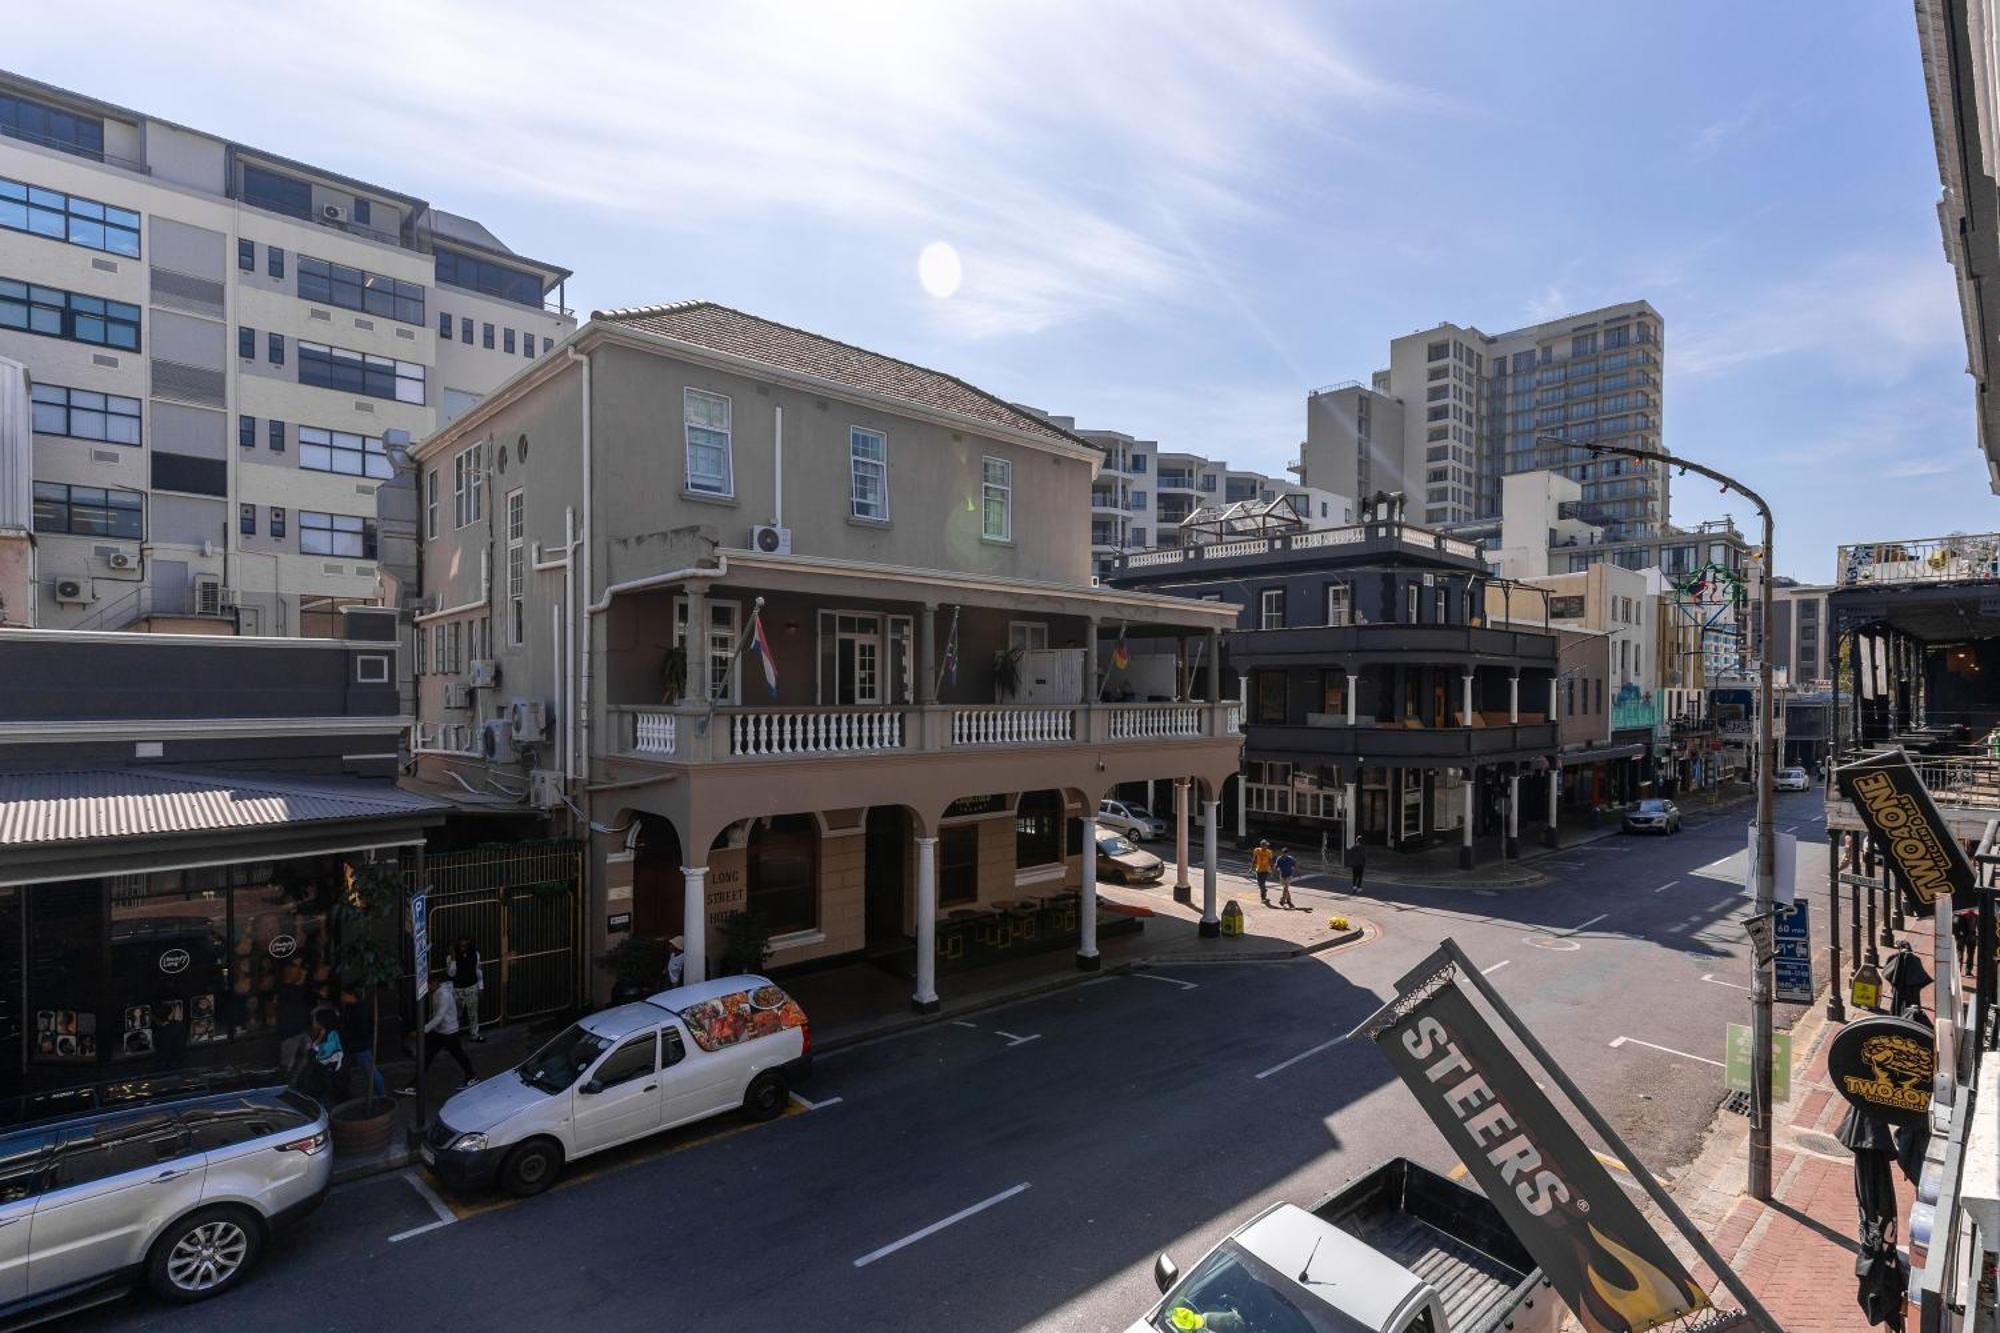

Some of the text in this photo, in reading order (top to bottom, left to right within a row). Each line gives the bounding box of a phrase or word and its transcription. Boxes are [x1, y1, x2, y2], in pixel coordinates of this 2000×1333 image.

[712, 870, 739, 884] LONG
[707, 889, 744, 905] STREET
[1777, 925, 1790, 933] 60
[1844, 1075, 1930, 1107] TWO4ON
[1402, 1016, 1570, 1217] STEERS
